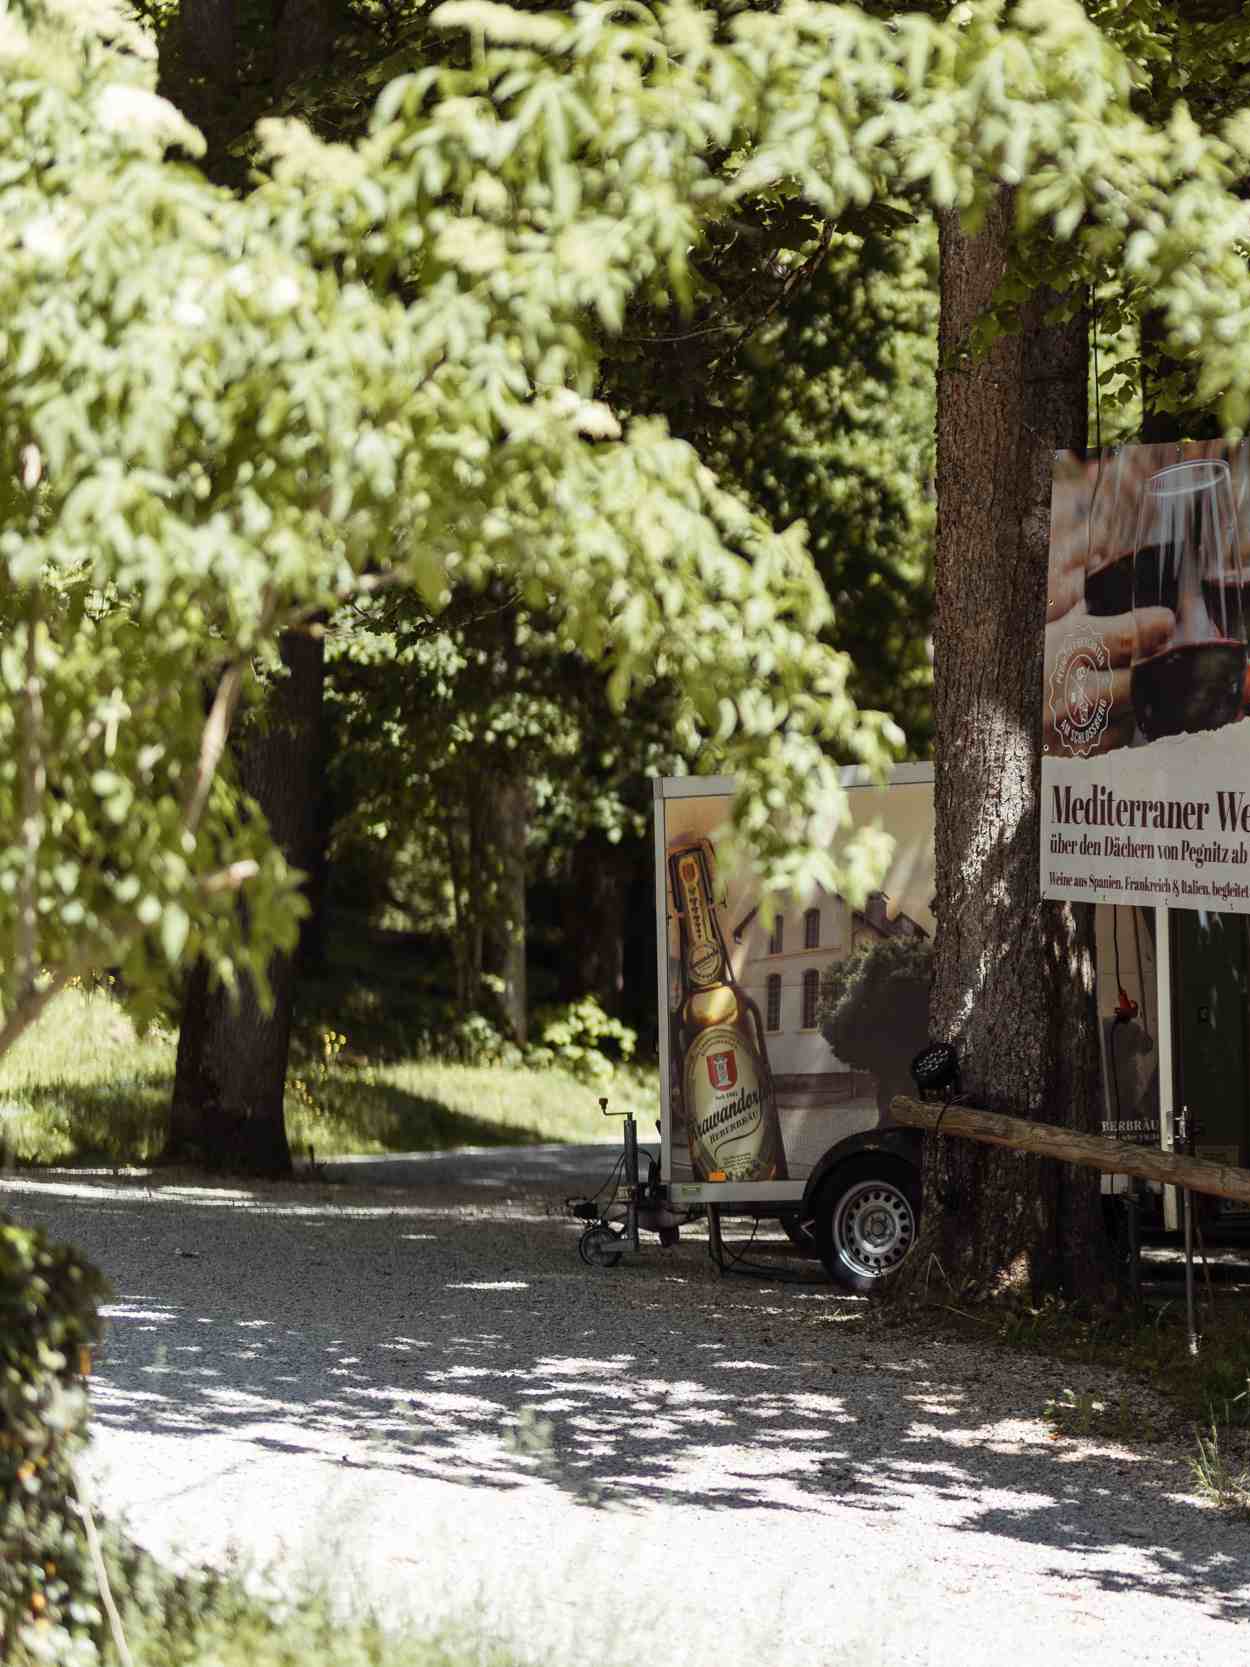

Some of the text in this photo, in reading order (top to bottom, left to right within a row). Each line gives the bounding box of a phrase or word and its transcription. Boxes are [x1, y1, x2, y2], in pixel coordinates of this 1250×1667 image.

[1051, 784, 1209, 831] Mediterraner
[1050, 833, 1078, 855] über
[1079, 834, 1102, 856] den
[1104, 835, 1155, 860] Dächern
[1157, 844, 1179, 861] von
[1181, 839, 1230, 869] Pegnitz
[1231, 841, 1248, 865] ab
[1049, 872, 1073, 887] Weine
[1073, 876, 1088, 888] aus
[1125, 876, 1171, 893] Frankreich
[1172, 879, 1180, 897] &
[1212, 880, 1250, 901] begleitet
